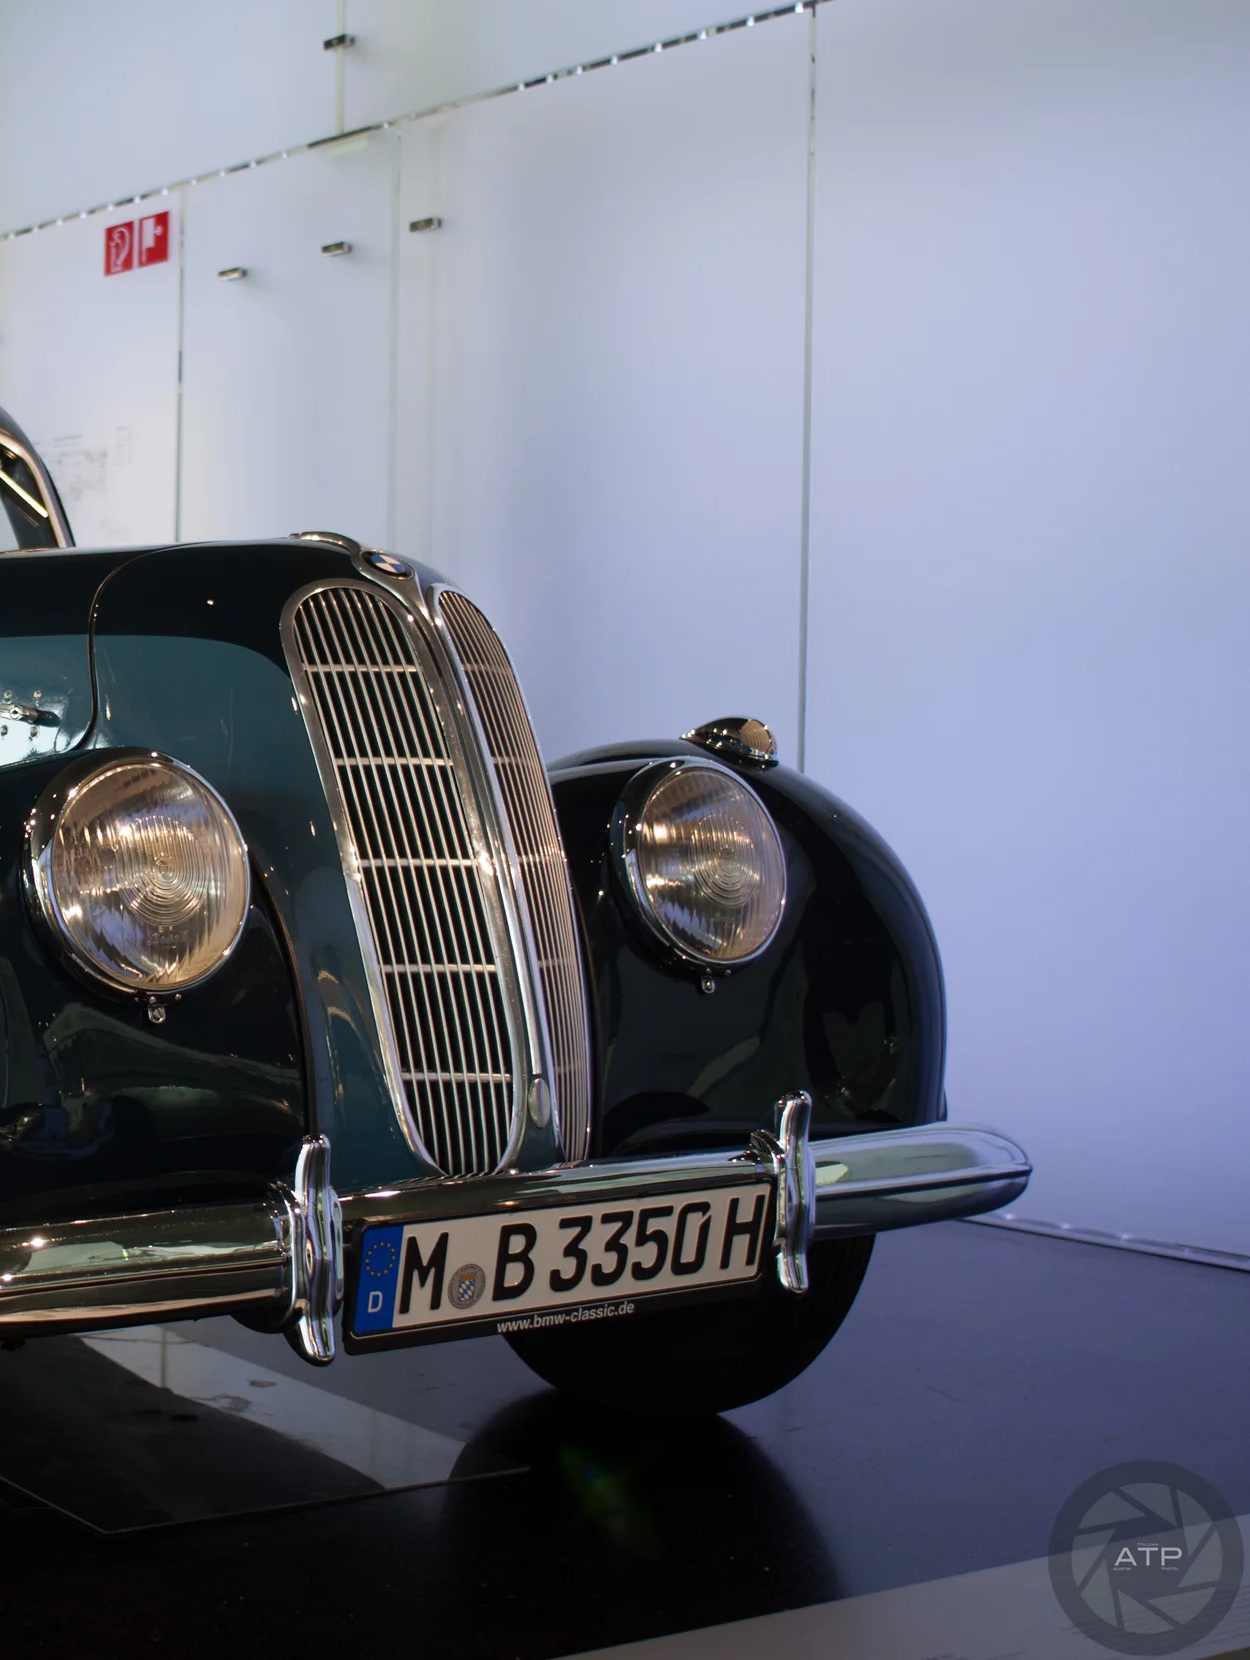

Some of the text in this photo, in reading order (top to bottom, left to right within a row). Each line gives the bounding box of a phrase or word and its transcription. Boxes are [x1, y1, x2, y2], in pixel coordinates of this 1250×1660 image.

[399, 1232, 449, 1314] M
[492, 1222, 537, 1301] B
[367, 1290, 383, 1314] D
[496, 1301, 635, 1333] www.bmw-classic.de
